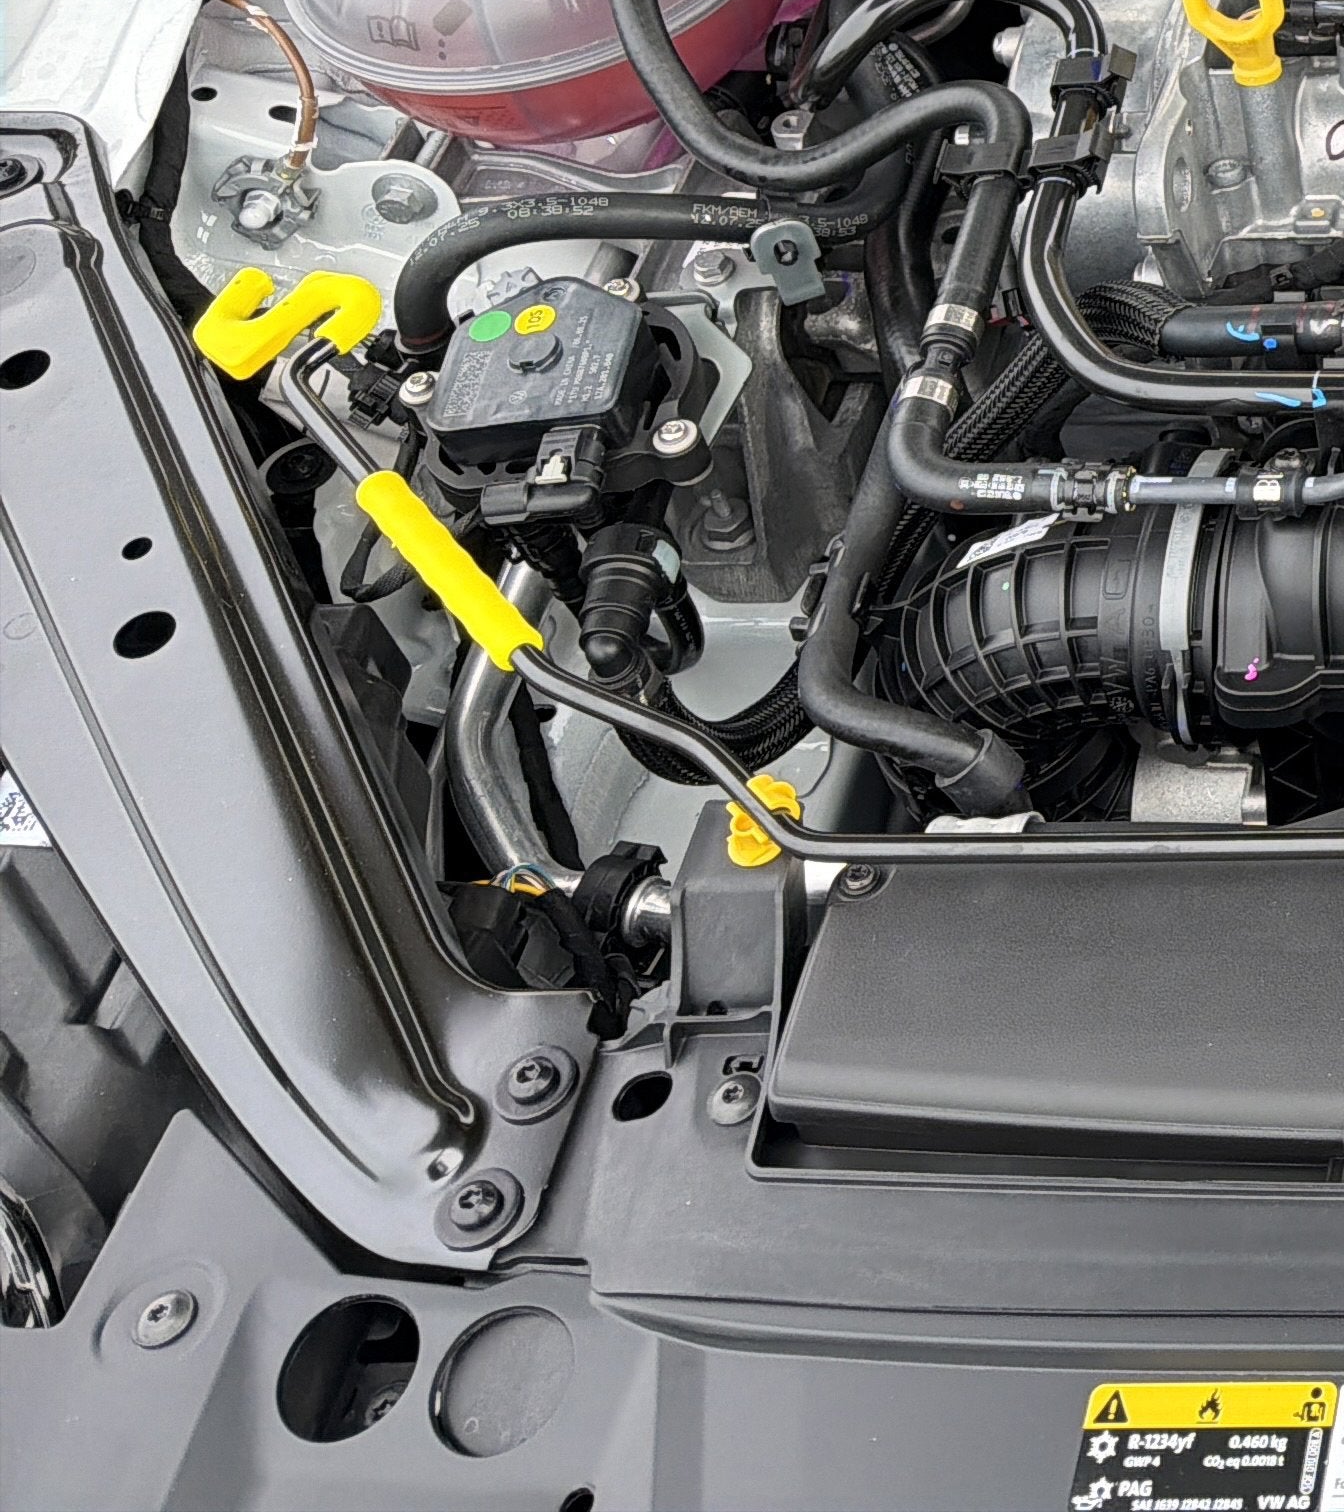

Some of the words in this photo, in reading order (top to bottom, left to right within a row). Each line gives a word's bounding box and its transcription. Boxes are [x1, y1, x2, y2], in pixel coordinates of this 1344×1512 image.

[1127, 1432, 1196, 1454] R-1234yf
[1270, 1435, 1288, 1453] kg
[1123, 1455, 1149, 1468] GWP
[1226, 1457, 1240, 1470] eq
[1116, 1480, 1154, 1497] PAG
[1257, 1495, 1284, 1510] VW
[1285, 1495, 1311, 1510] AG
